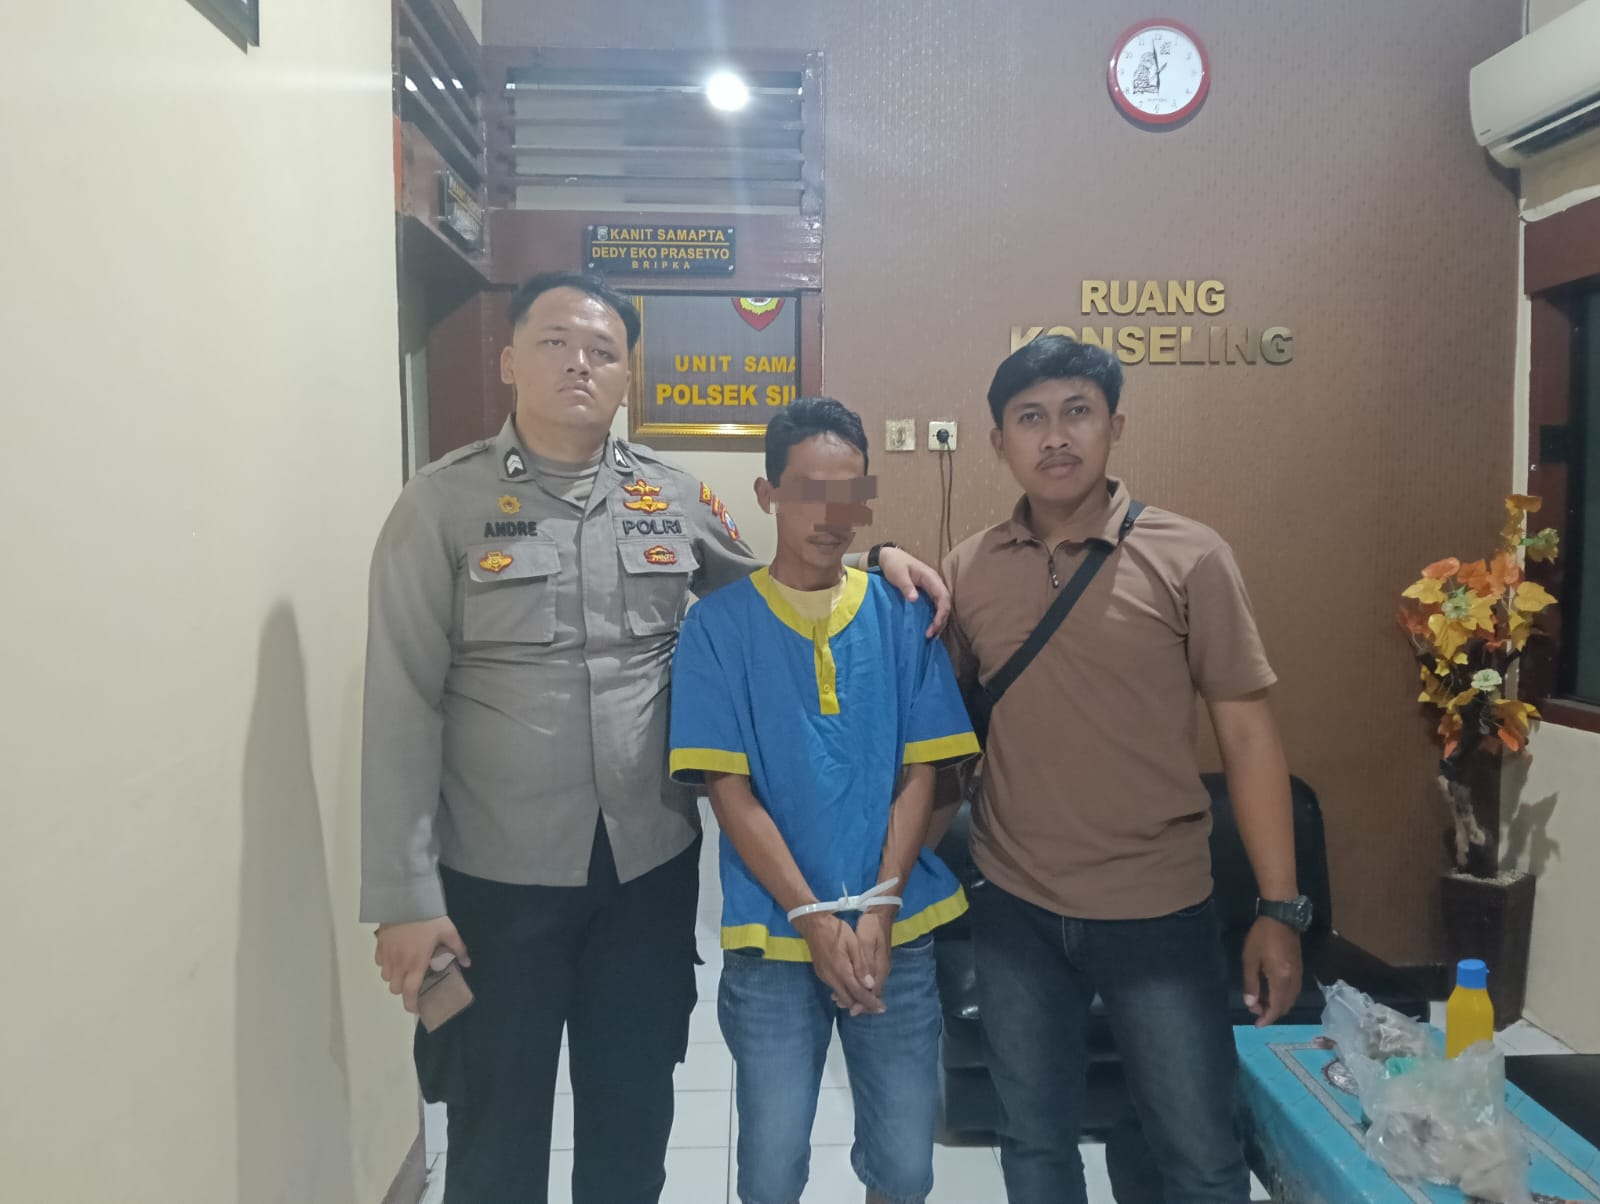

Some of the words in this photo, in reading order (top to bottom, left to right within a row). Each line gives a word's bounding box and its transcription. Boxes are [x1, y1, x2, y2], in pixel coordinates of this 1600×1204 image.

[610, 229, 653, 241] KANIT
[657, 229, 725, 241] SAMAPTA
[592, 247, 627, 258] DEDY
[630, 247, 657, 258] EKO
[660, 248, 730, 260] PRASETYO
[1080, 280, 1225, 314] RUANG
[1010, 326, 1294, 364] KNSELING
[675, 355, 732, 373] UNIT
[656, 384, 758, 406] POLSEK
[484, 521, 538, 538] ANDRE
[622, 519, 682, 536] POLRI
